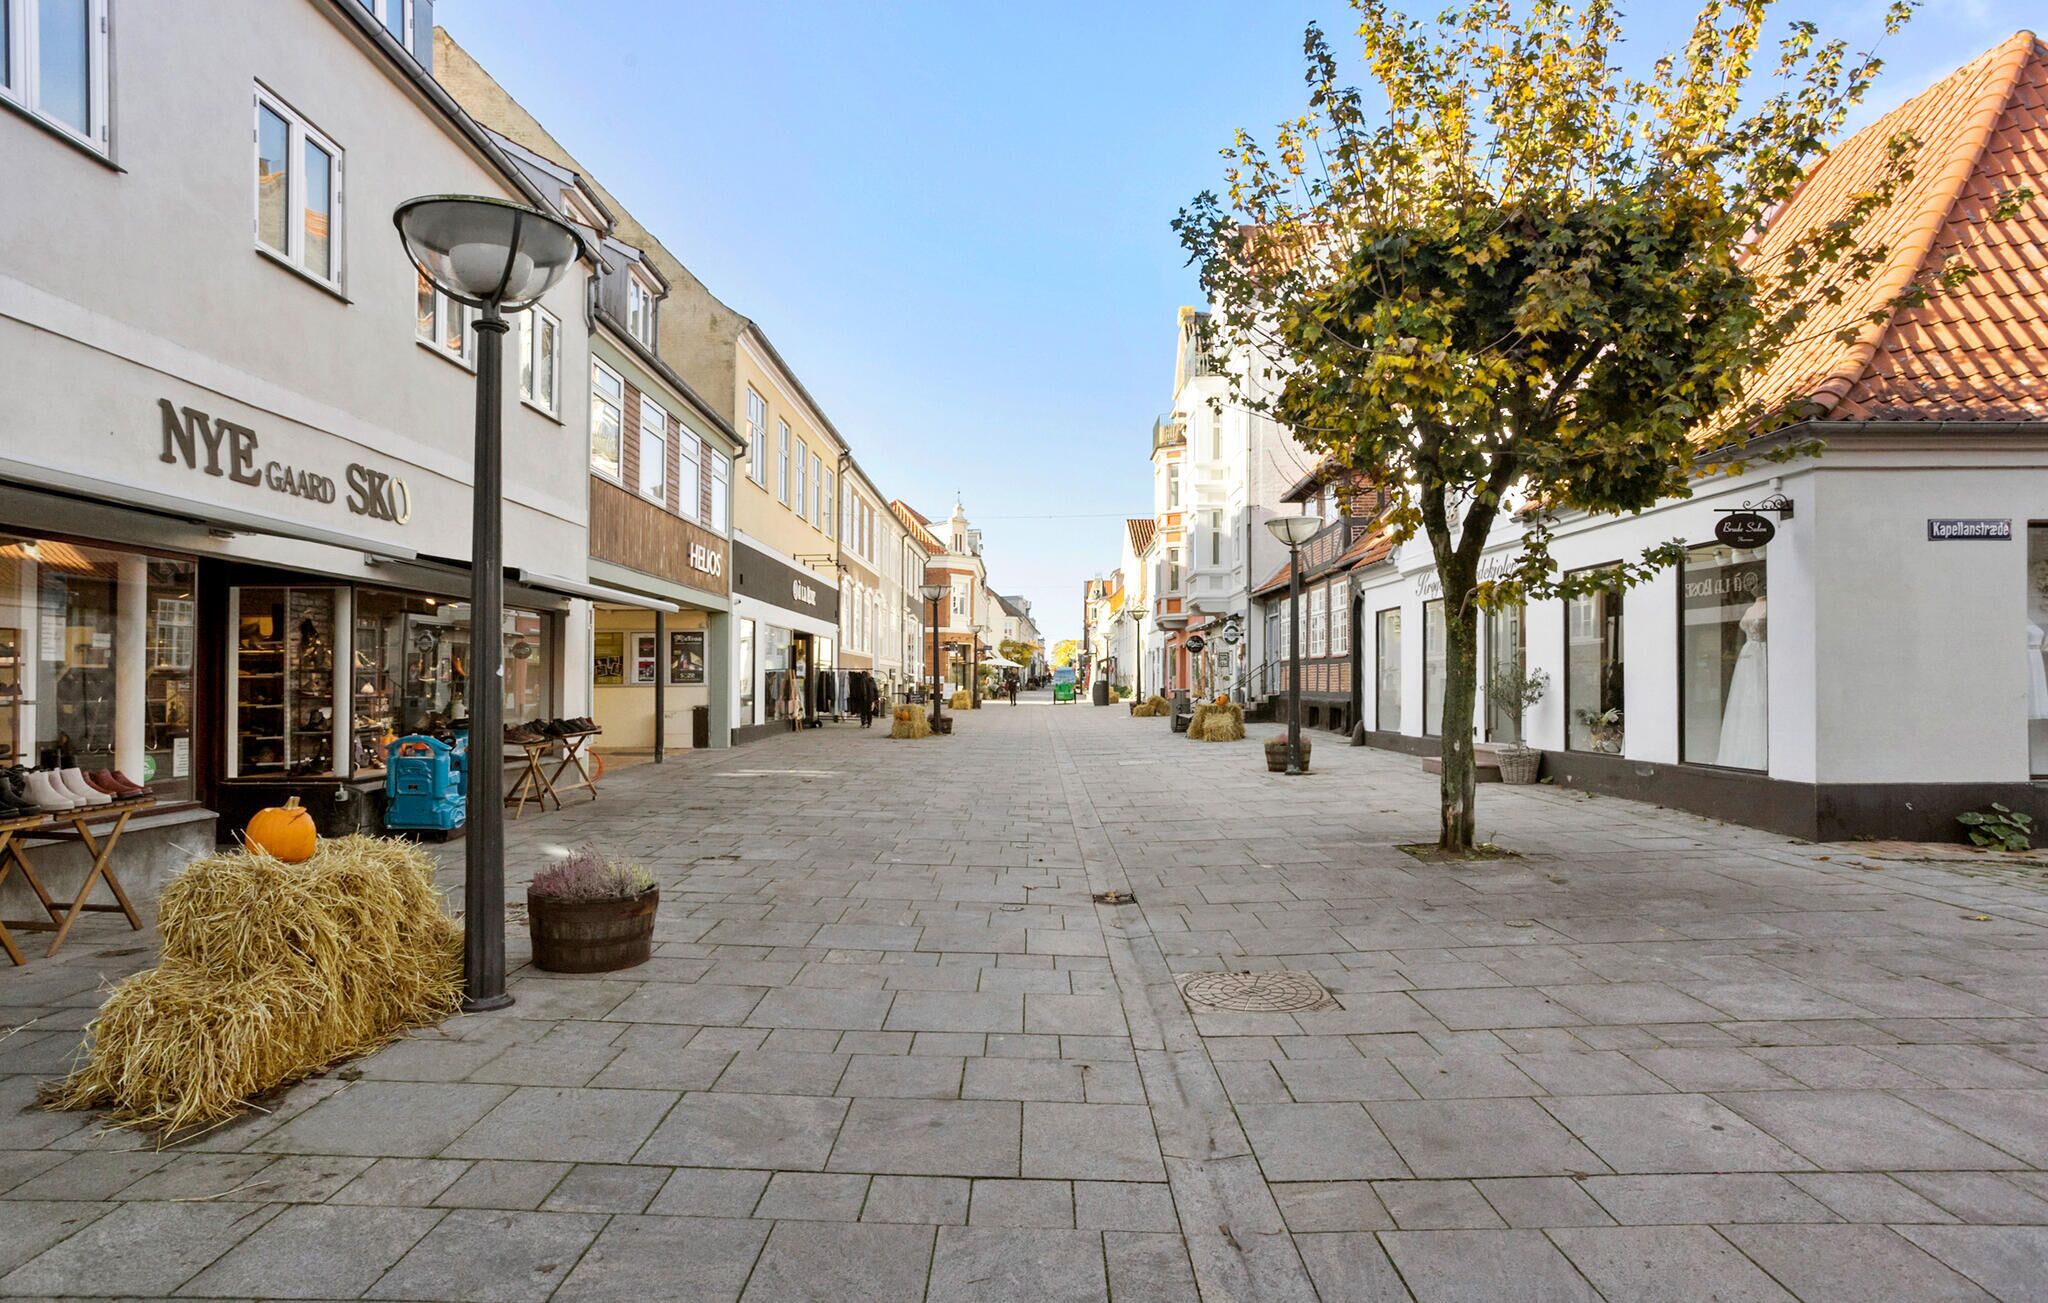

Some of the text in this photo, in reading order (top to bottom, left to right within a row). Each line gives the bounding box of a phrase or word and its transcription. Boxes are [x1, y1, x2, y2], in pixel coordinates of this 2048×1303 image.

[158, 397, 412, 525] NYE GAARD SKO
[1932, 521, 2010, 539] Kapellanstræde
[689, 542, 721, 577] HELIOS
